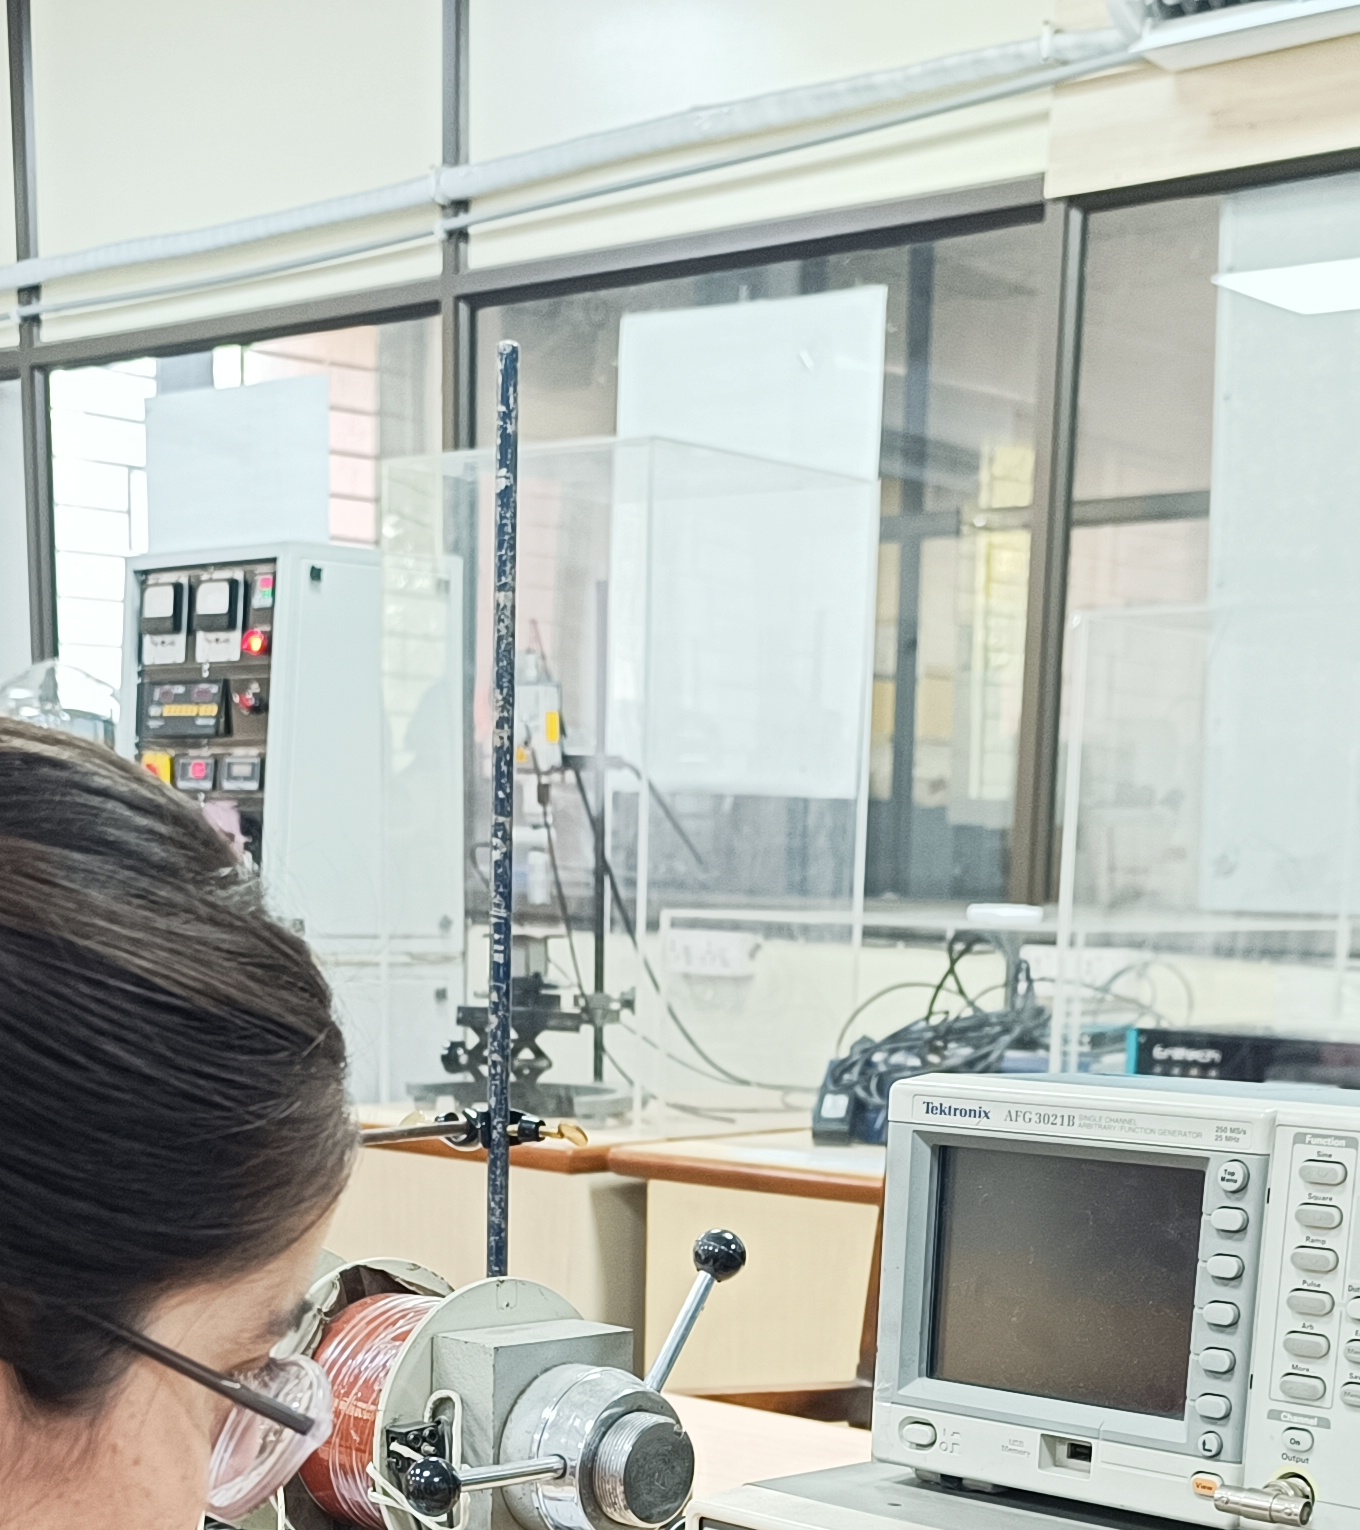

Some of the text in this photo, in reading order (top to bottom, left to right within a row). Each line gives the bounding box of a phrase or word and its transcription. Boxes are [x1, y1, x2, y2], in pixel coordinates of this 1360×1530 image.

[923, 1101, 1075, 1127] Tektronix AFG 3021B
[1078, 1114, 1137, 1125] SINGLE CHANNEL
[1158, 1128, 1203, 1138] GENERATOR
[1230, 1127, 1246, 1135] MS/s
[1305, 1135, 1345, 1146] Function
[1224, 1169, 1235, 1177] Top
[1308, 1193, 1332, 1201] Square
[1306, 1236, 1326, 1245] Ramp
[1302, 1280, 1321, 1288] Pulse
[1302, 1323, 1314, 1331] Arb
[1281, 1413, 1318, 1426] Channel
[1290, 1437, 1300, 1446] On
[1281, 1453, 1309, 1464] Output
[1196, 1482, 1214, 1491] View
